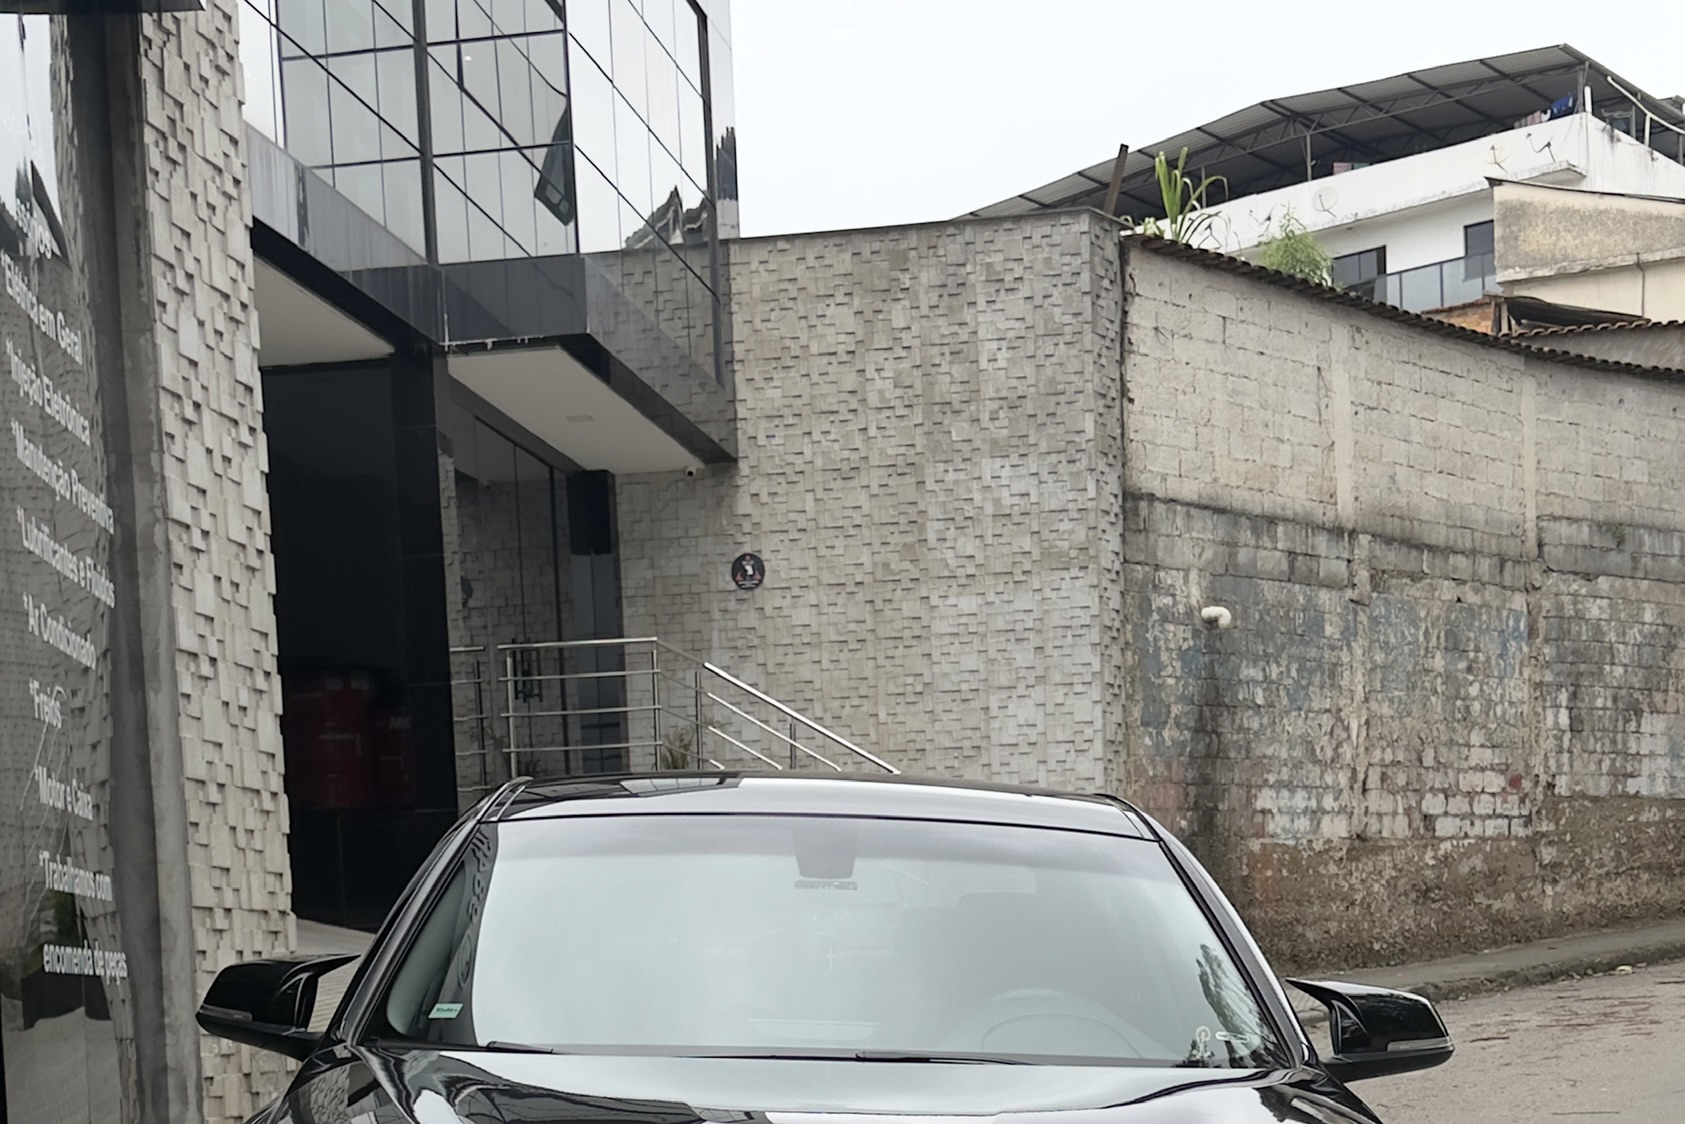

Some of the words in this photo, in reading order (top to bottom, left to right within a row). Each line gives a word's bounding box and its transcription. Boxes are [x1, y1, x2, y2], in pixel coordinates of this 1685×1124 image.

[39, 303, 56, 341] em
[57, 310, 82, 365] Geral
[43, 375, 91, 447] Eletrônica
[71, 468, 115, 535] Preventiva
[79, 560, 86, 588] e
[86, 556, 116, 609] Fluidos
[40, 603, 96, 670] Condicionado
[66, 785, 72, 813] e
[72, 779, 94, 821] Caixa
[96, 873, 113, 901] com
[43, 939, 94, 976] encomenda
[95, 940, 105, 977] de
[105, 951, 128, 986] peças
